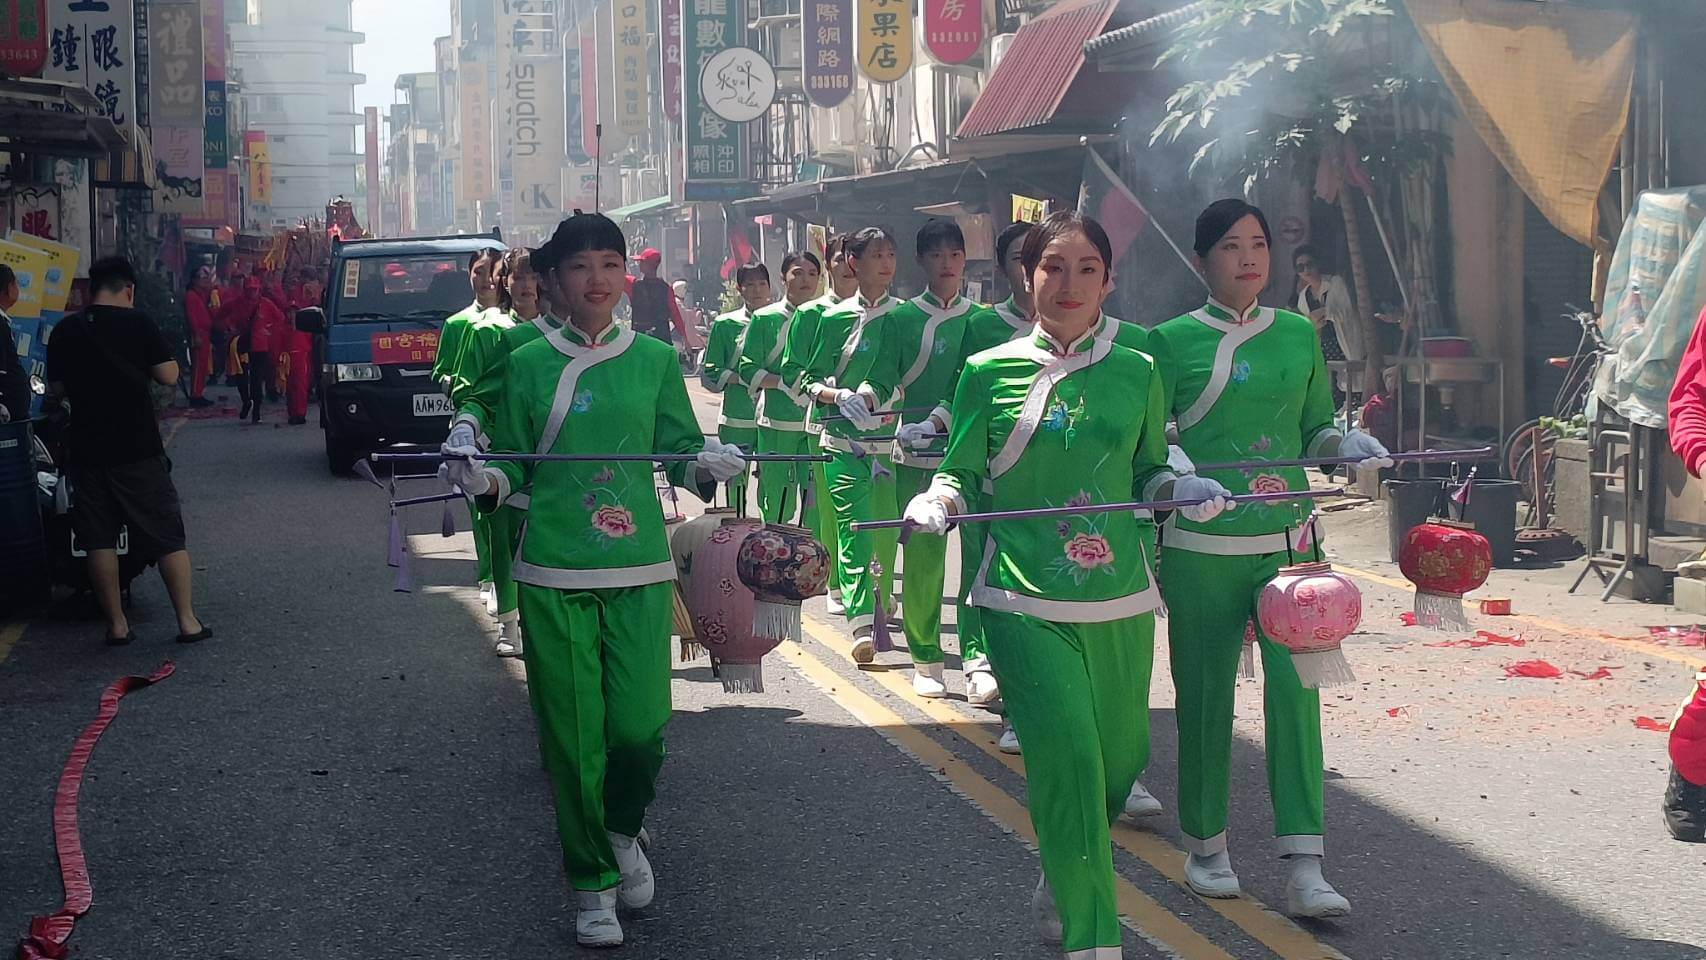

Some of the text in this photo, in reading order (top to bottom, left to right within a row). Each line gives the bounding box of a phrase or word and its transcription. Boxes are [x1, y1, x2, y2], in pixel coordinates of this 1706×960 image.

[815, 3, 841, 68] 際網路
[515, 63, 541, 157] swatch
[717, 144, 735, 174] 沖印
